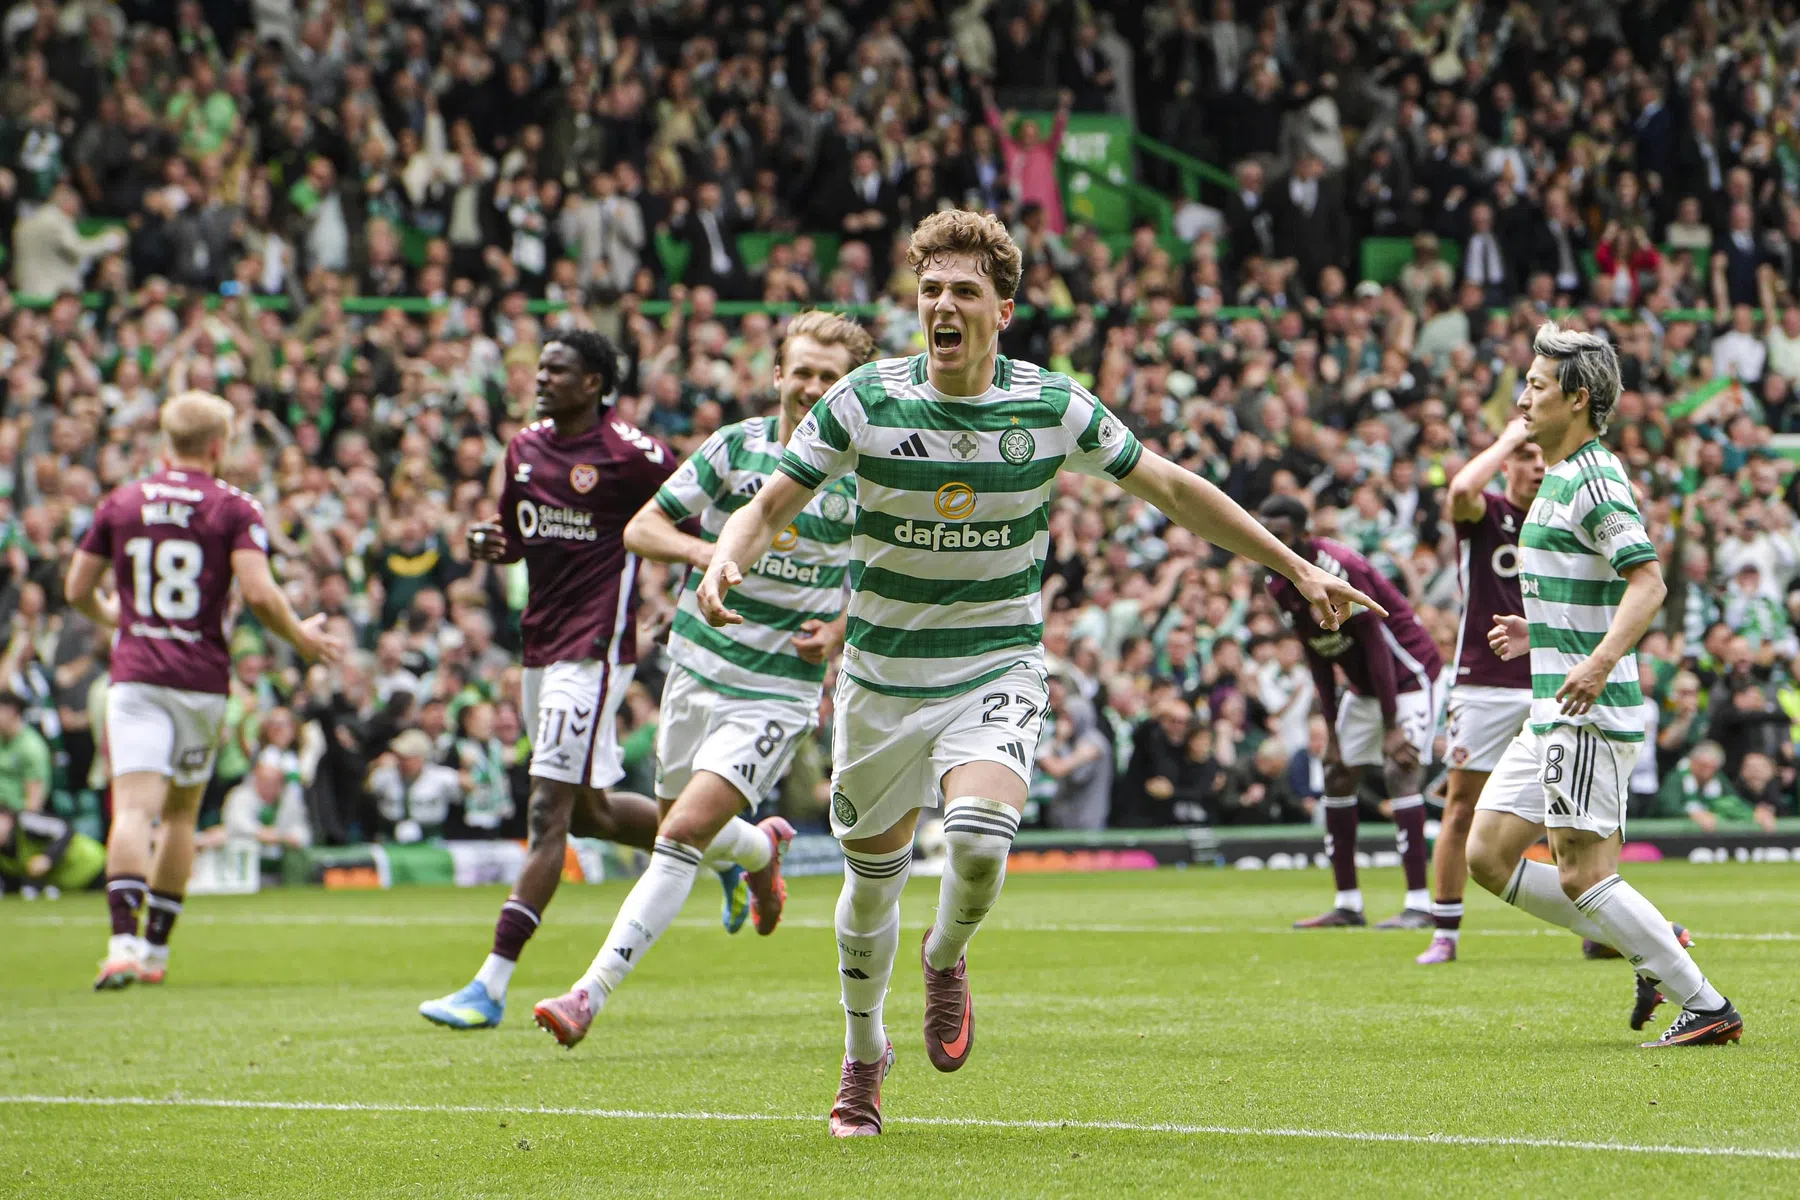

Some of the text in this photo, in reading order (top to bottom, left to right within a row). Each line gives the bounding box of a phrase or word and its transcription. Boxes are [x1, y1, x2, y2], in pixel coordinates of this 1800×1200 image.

[538, 504, 594, 527] Stellar
[538, 520, 598, 541] Omada
[1606, 521, 1643, 538] FOUNDATIO
[894, 519, 1012, 553] dafabet
[124, 536, 204, 620] 18
[752, 550, 821, 584] fabet
[981, 692, 1039, 730] 27
[755, 719, 784, 758] 8
[1543, 744, 1565, 785] 8
